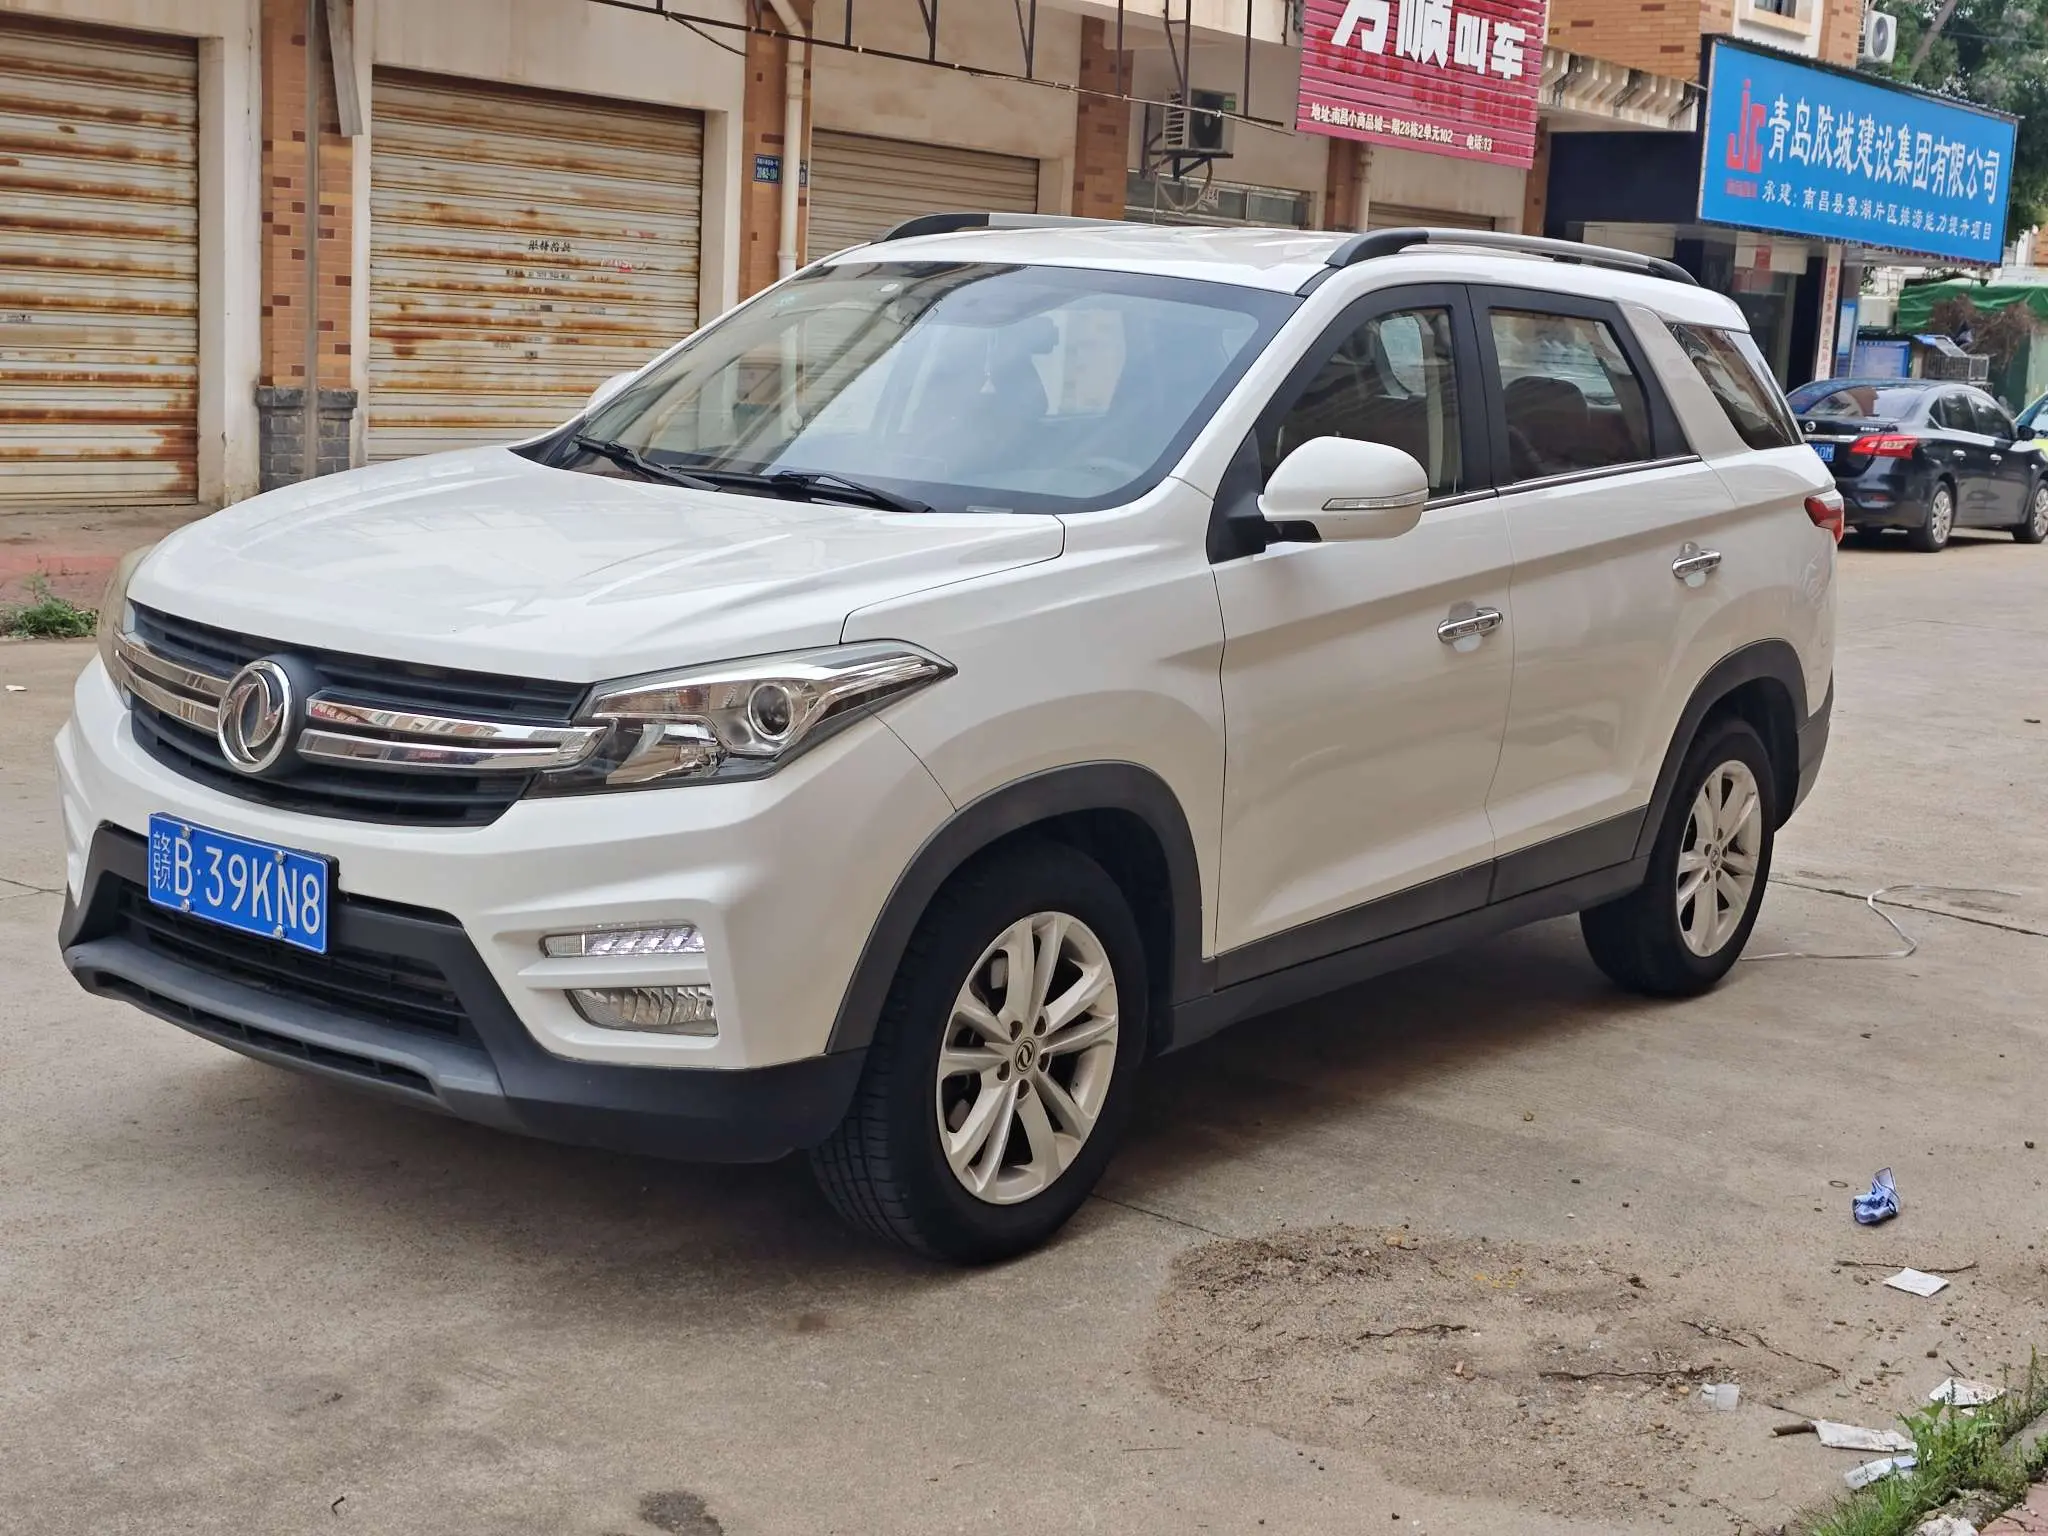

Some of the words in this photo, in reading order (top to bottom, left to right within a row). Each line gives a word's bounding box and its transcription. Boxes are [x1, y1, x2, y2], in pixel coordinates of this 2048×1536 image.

[1767, 93, 2000, 204] 青岛胶城建设集团有限公司
